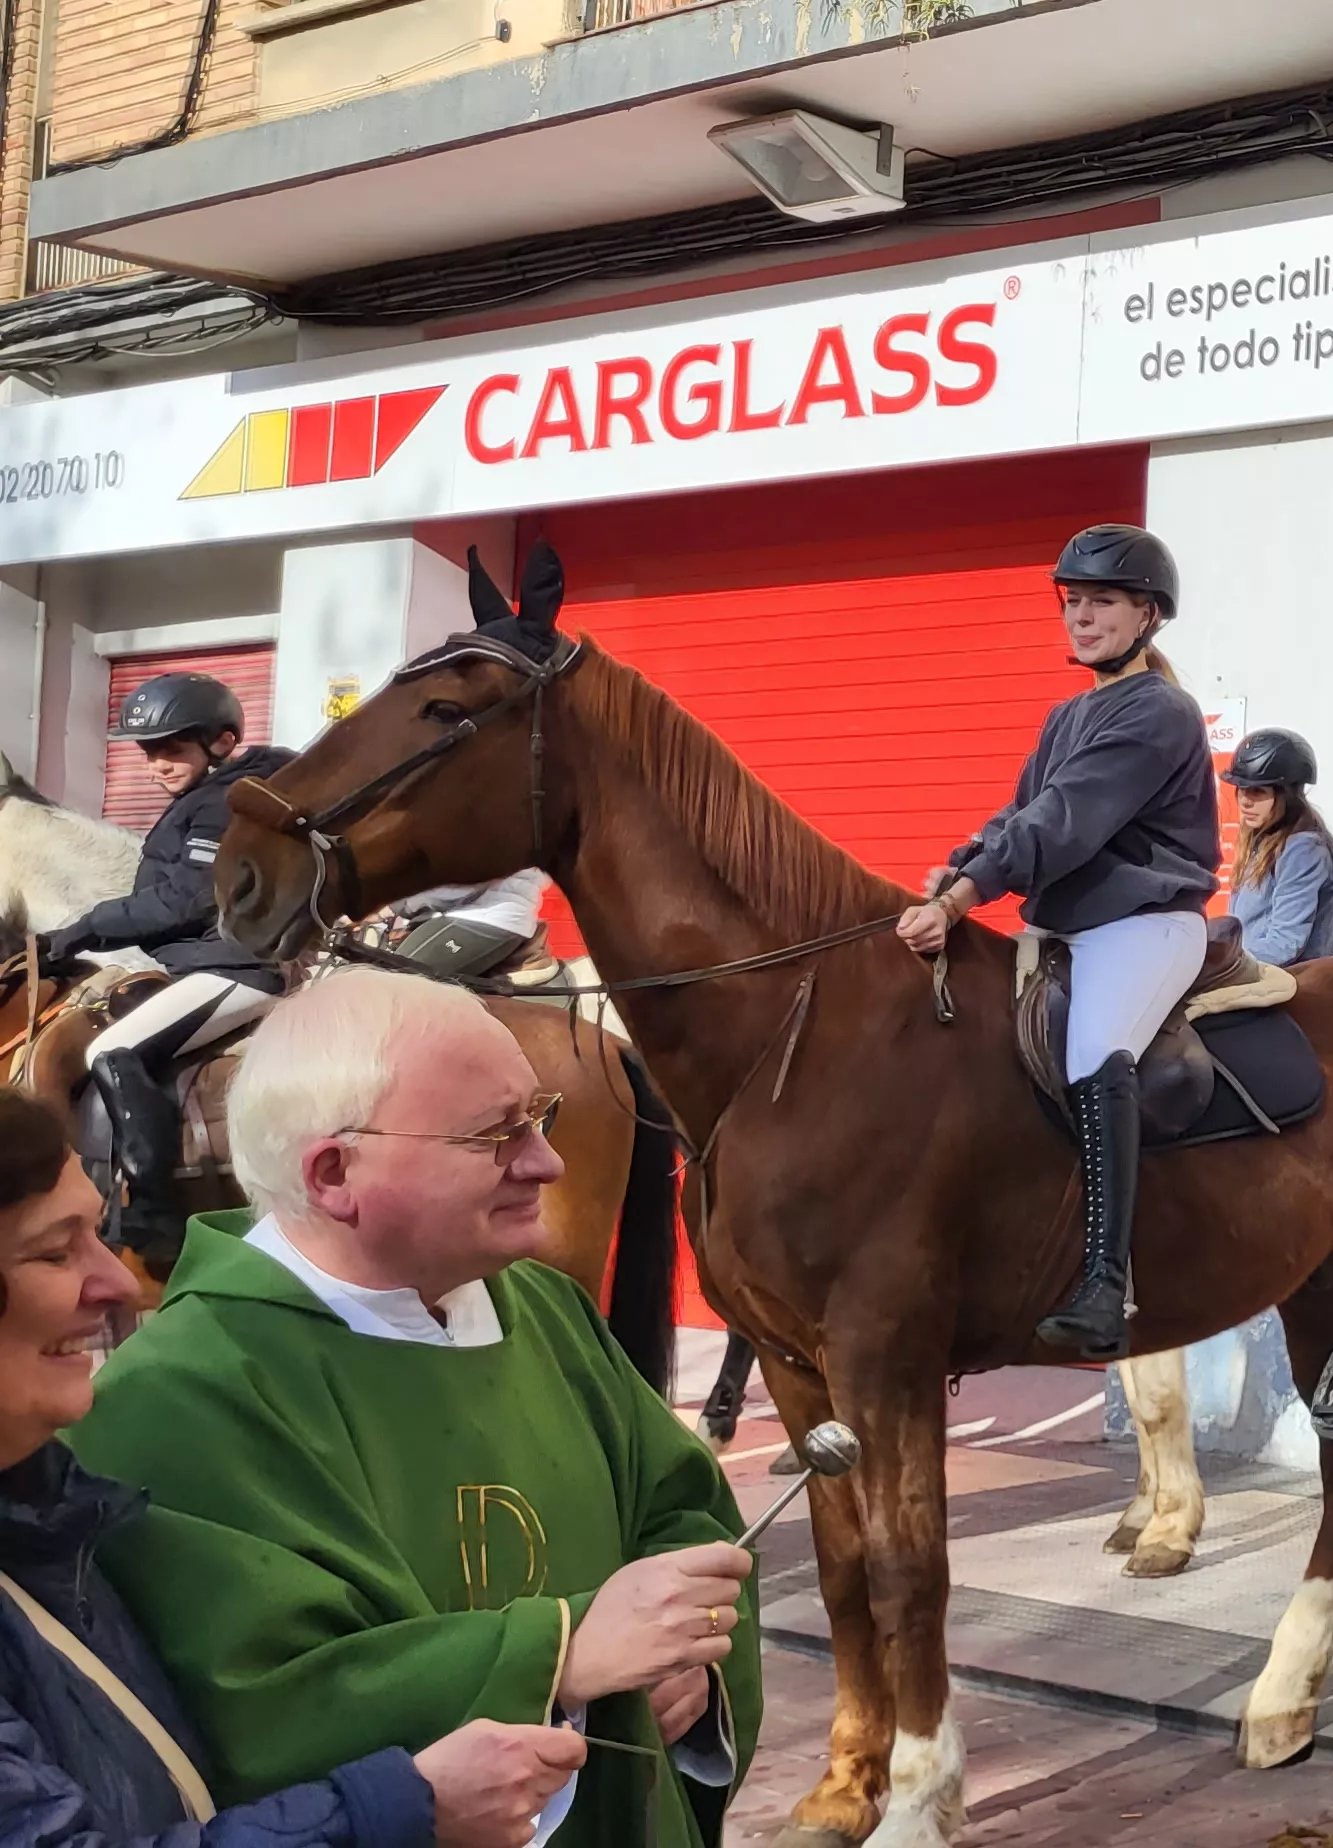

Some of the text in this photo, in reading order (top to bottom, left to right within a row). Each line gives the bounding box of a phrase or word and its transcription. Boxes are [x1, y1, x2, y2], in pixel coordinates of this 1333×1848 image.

[1123, 281, 1154, 323] el
[1140, 341, 1185, 381] de
[1197, 328, 1280, 374] todo
[464, 302, 998, 465] CARGLASS
